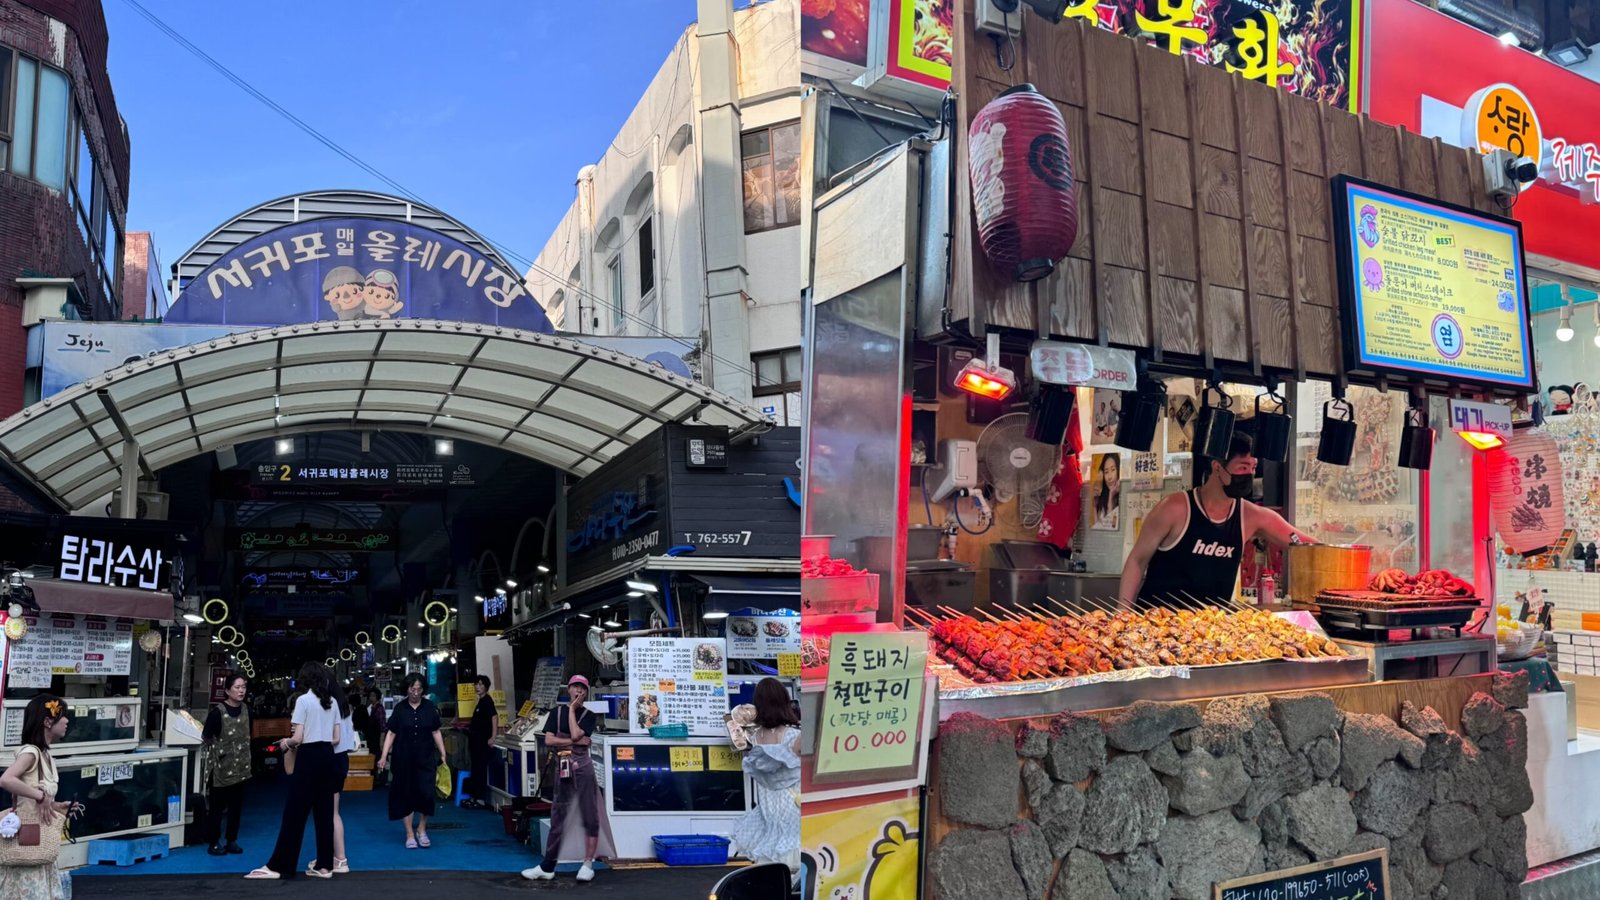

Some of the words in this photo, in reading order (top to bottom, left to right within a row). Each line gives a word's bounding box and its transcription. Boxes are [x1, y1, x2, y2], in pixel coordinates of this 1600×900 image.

[1436, 237, 1452, 246] BEST
[207, 232, 330, 300] 서귀포
[336, 228, 354, 256] 매일
[65, 333, 104, 352] Jeju
[1092, 368, 1128, 382] ORDER
[1454, 406, 1484, 432] 대기
[1484, 420, 1510, 431] PICK-UP
[280, 464, 291, 481] 2
[298, 467, 389, 479] 서귀포매일올레시장
[698, 531, 752, 546] 762-5577
[1192, 539, 1235, 558] hdex
[60, 535, 163, 589] 탐라수산
[841, 642, 909, 674] 흑돼지
[833, 679, 910, 707] 철판구이
[834, 730, 907, 753] 10.000
